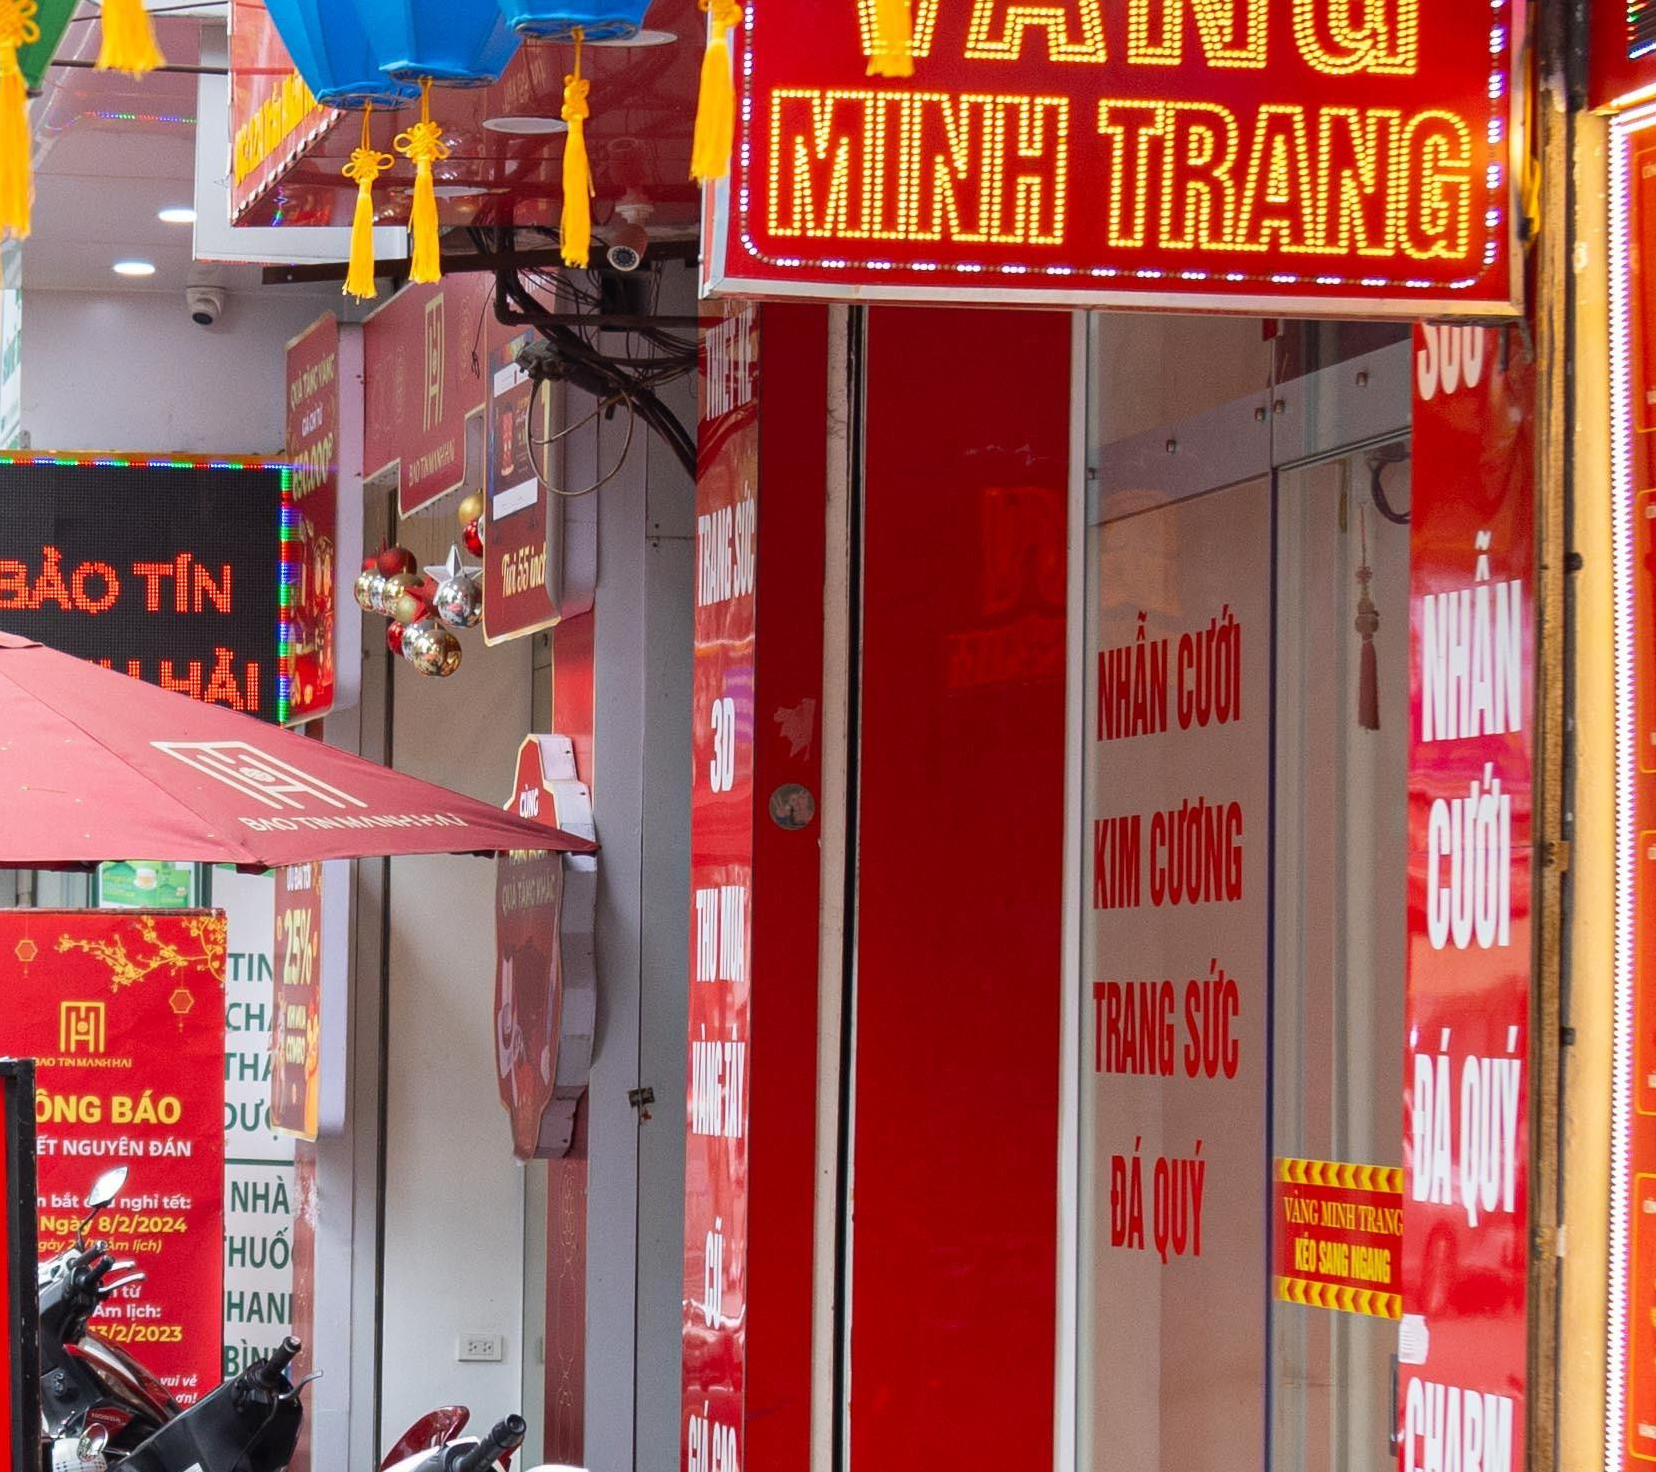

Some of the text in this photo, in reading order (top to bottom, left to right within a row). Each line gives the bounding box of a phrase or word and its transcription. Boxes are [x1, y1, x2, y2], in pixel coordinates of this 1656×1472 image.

[766, 87, 1472, 261] MINH TRANG
[134, 551, 233, 615] TÍN
[698, 478, 755, 608] TRANG SỨC
[1096, 610, 1242, 744] NHẪN CƯỚI
[1421, 529, 1523, 744] NHẪN
[710, 696, 735, 795] 3D
[1093, 798, 1244, 913] KIM CƯƠNG
[1427, 760, 1512, 951] CƯỚI
[282, 907, 313, 986] 25%
[695, 884, 745, 984] THU MUA
[1093, 957, 1240, 1082] TRANG SỨC
[111, 1089, 182, 1124] BÁO
[692, 1022, 724, 1138] VÀNG
[1413, 1024, 1523, 1229] ĐÁ QUÝ
[35, 1136, 192, 1157] ẾT NGUYÊN ĐÁN
[230, 1174, 290, 1216] NHÀ
[40, 1216, 188, 1236] Ngày 8/2/2024
[50, 1192, 192, 1211] bắt nghỉ tết:
[1110, 1135, 1206, 1263] ĐÁ QUÝ
[1283, 1189, 1404, 1237] VÀNG MINH TRANG
[1318, 1239, 1350, 1278] SANG
[1350, 1243, 1392, 1285] NGANG
[126, 1304, 162, 1322] lịch:
